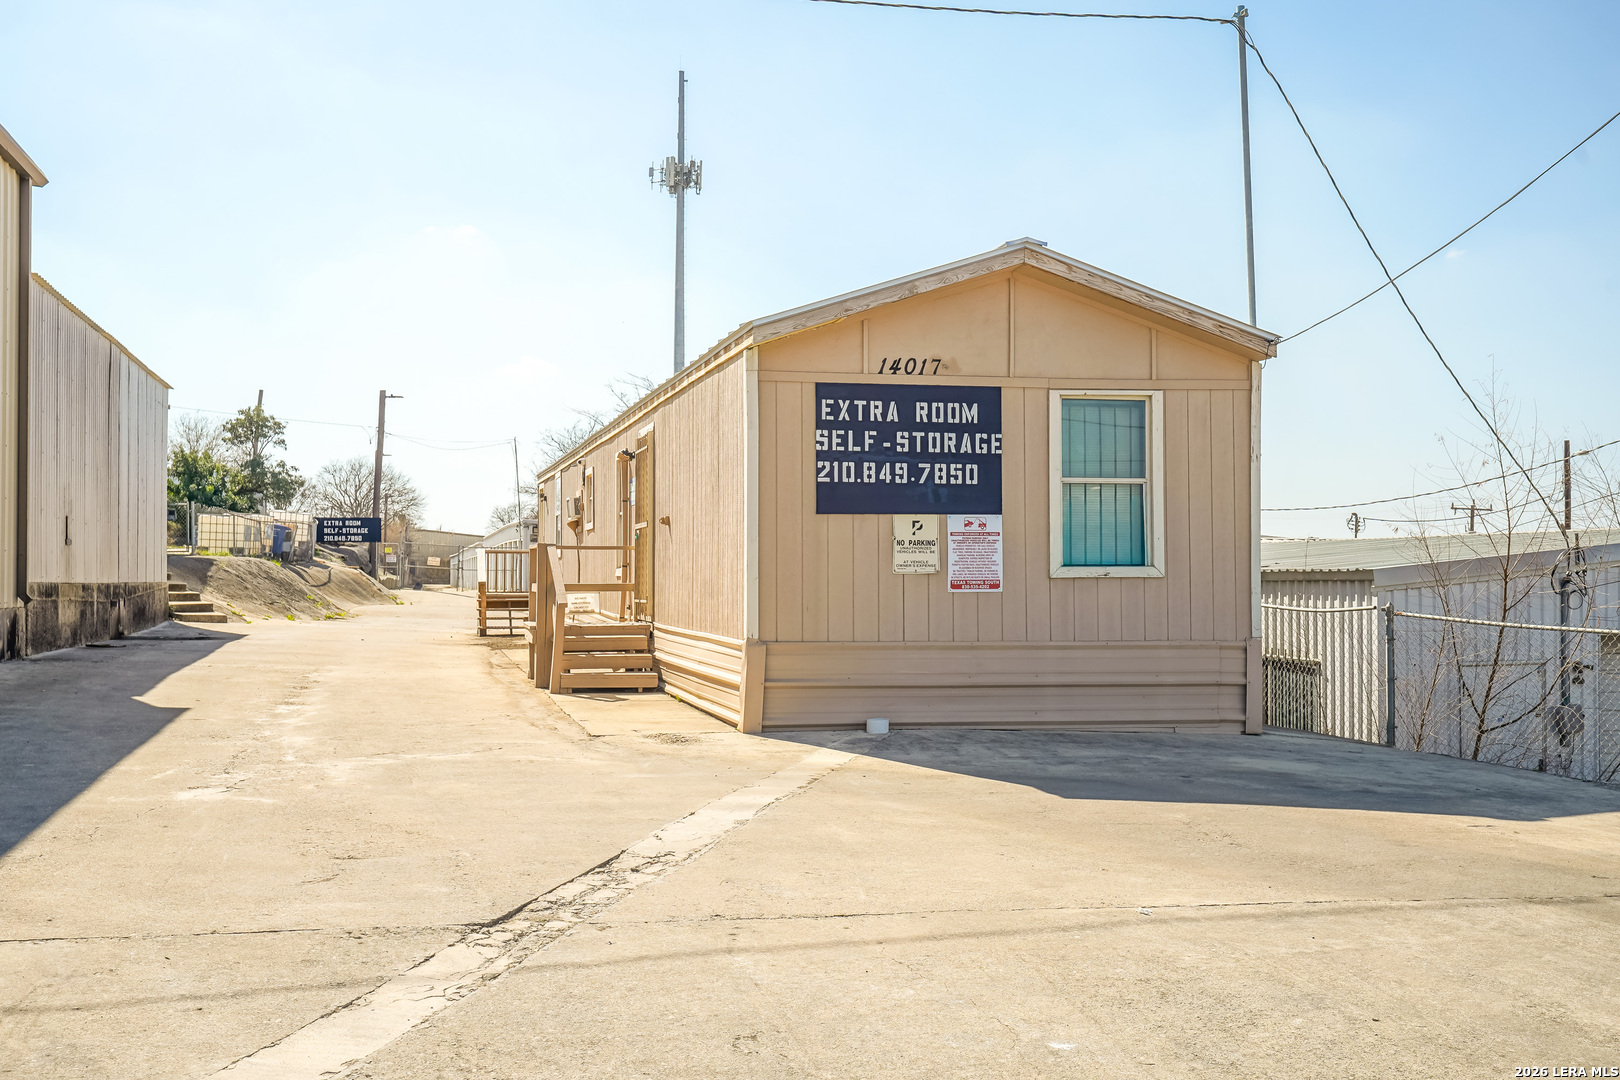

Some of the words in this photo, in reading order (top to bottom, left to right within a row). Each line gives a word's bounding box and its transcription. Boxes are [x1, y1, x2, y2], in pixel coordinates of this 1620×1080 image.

[878, 357, 942, 375] 14017
[821, 399, 899, 423] EXTRA
[915, 401, 978, 424] ROOM
[817, 460, 979, 485] 210.849.7850
